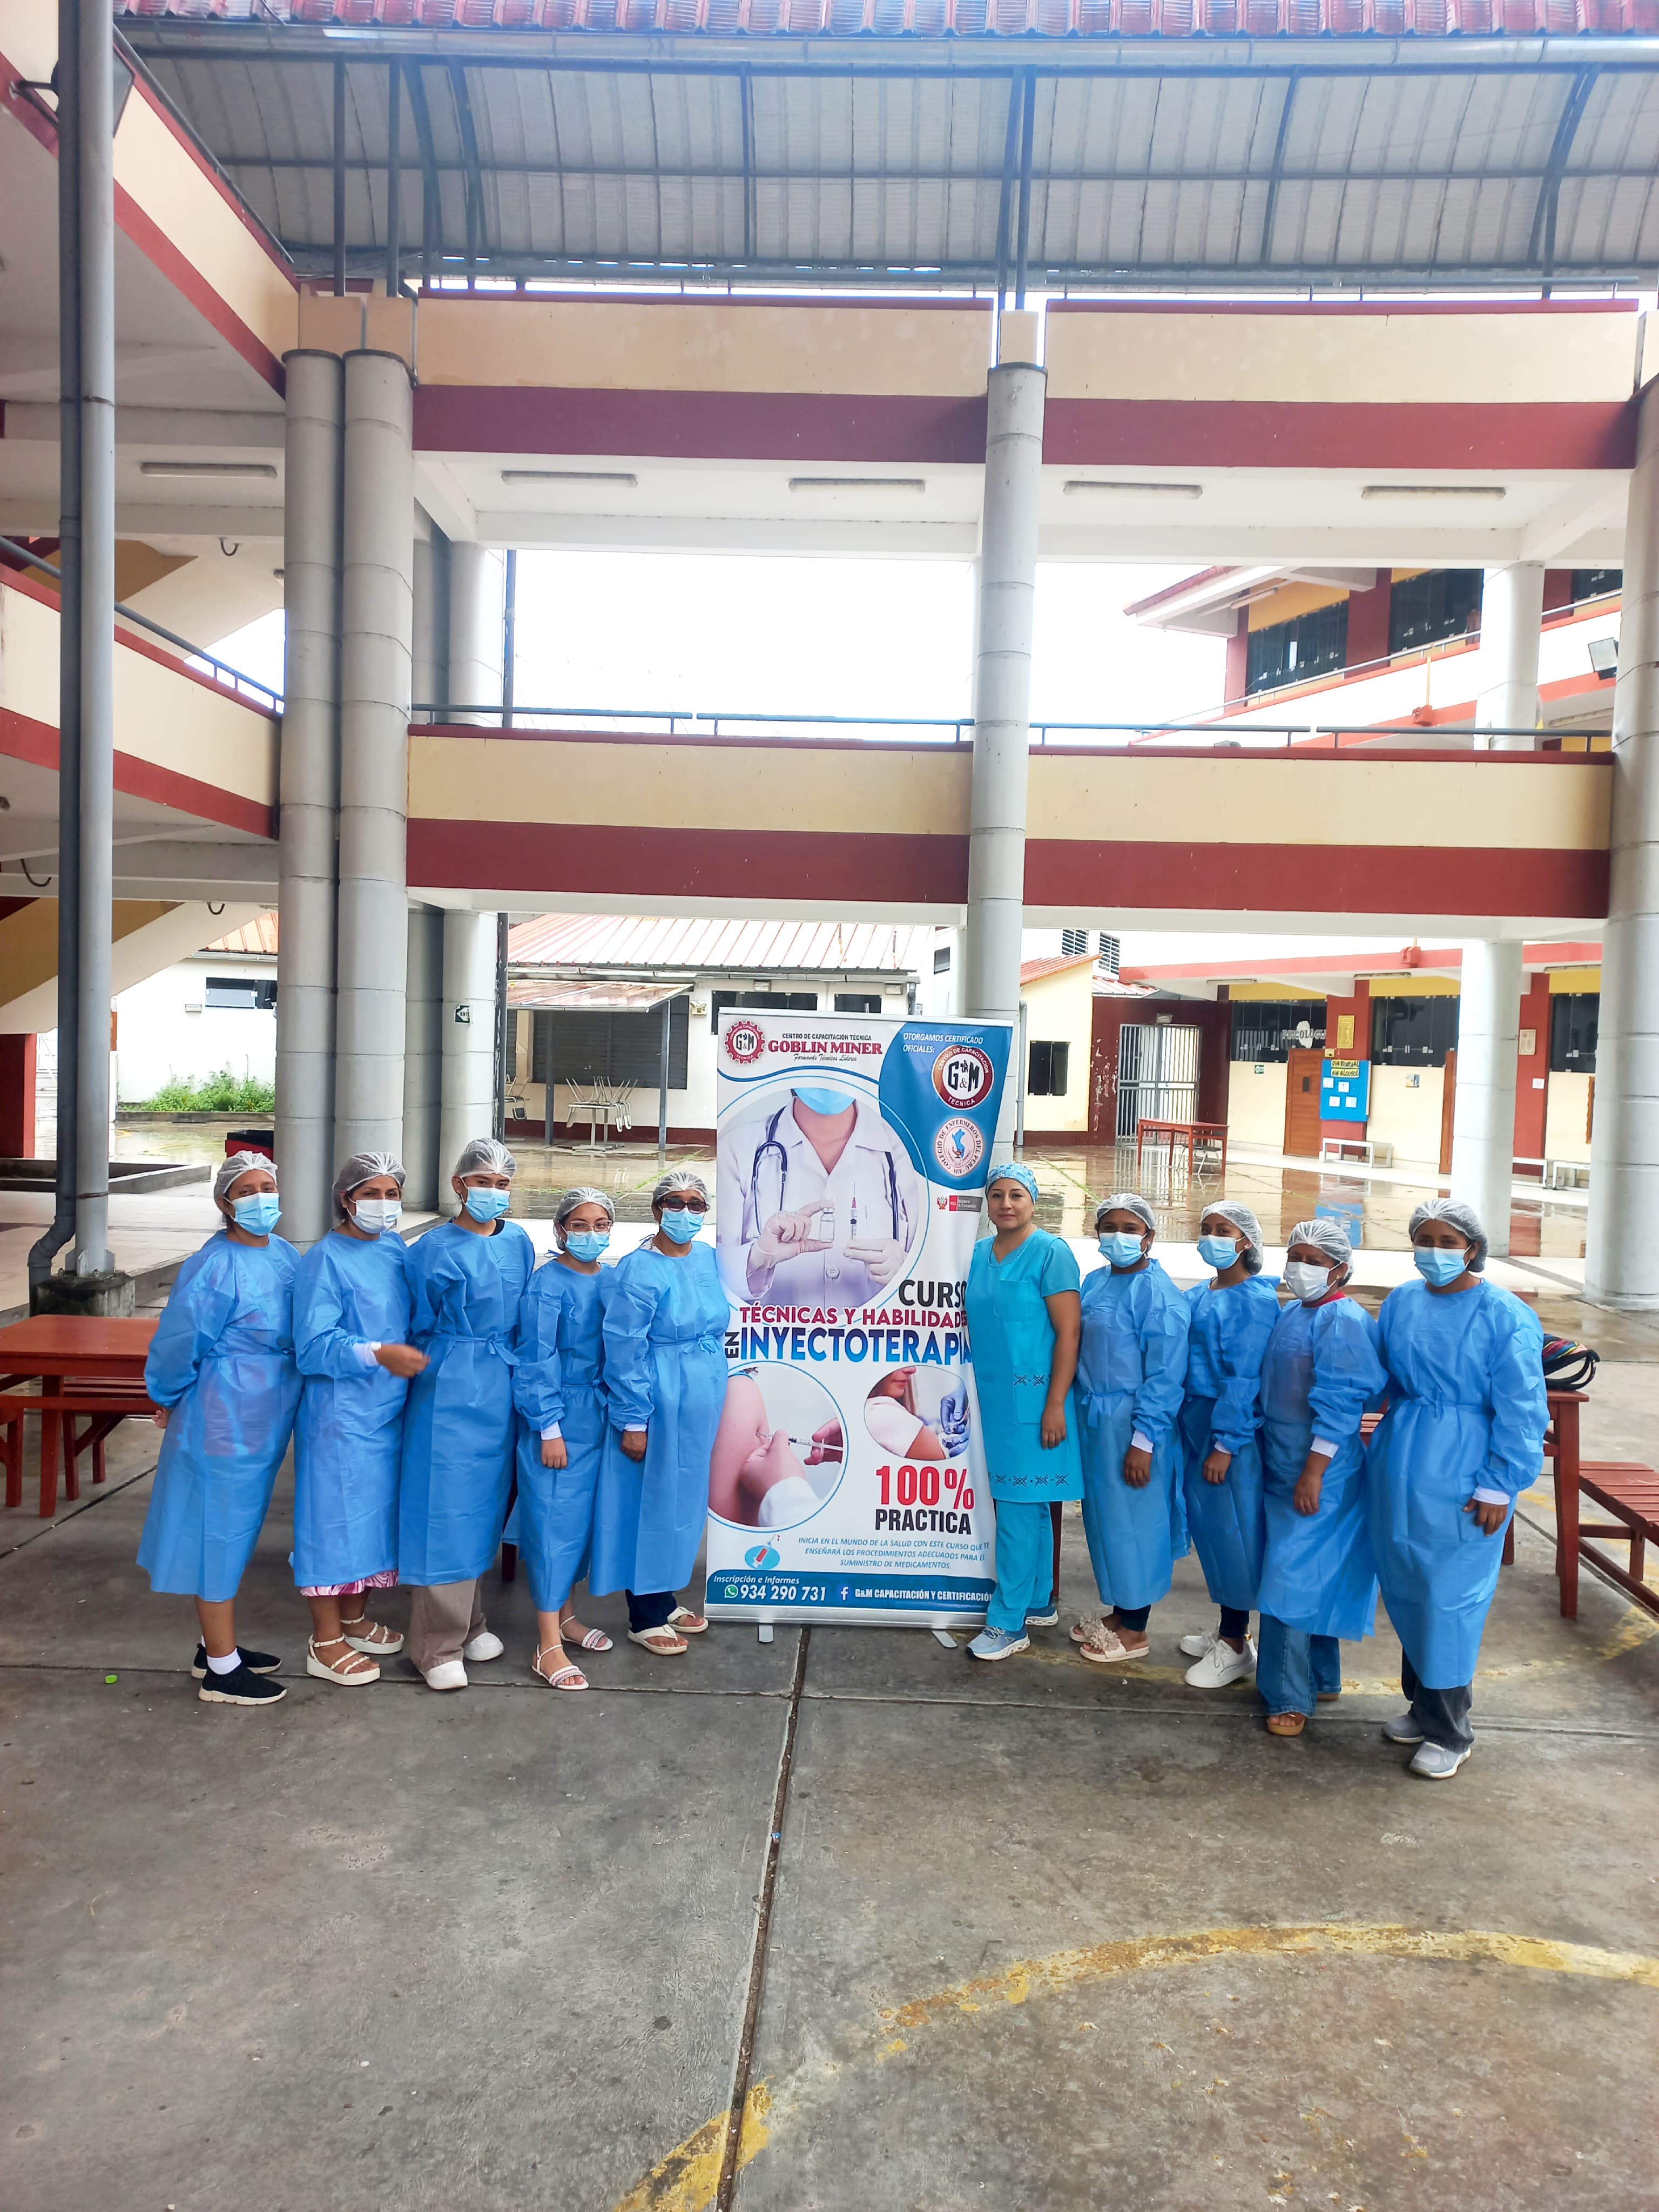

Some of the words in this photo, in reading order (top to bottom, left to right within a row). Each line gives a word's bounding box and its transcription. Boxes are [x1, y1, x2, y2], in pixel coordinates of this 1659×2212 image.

[768, 1040, 828, 1053] GOBLIN
[831, 1042, 883, 1054] MINER
[903, 1033, 943, 1042] OTORGAMOS
[945, 1034, 983, 1044] CERTIFICADO
[903, 1044, 935, 1053] OFICIALES:
[938, 1050, 953, 1070] CENTRO
[948, 1096, 976, 1107] TECNICA
[939, 1129, 946, 1139] DE
[945, 1119, 980, 1138] ENFERMEROS
[937, 1141, 951, 1170] COLEGIO
[899, 1279, 967, 1308] CURSO
[740, 1302, 838, 1324] TÉCNICAS
[844, 1309, 856, 1325] Y
[862, 1309, 968, 1328] HABILIDADES
[725, 1332, 739, 1359] EN
[741, 1327, 972, 1365] INYECTOTERAPIA
[876, 1465, 974, 1509] 100%
[875, 1509, 972, 1535] PRACTICA
[857, 1549, 916, 1558] PROCEDIMIENTOS
[918, 1550, 959, 1559] ADECUADOS
[895, 1561, 952, 1569] MEDICAMENTOS.
[714, 1575, 756, 1584] Inscripción
[765, 1576, 799, 1584] Informes
[740, 1584, 766, 1600] 934
[771, 1586, 797, 1600] 290
[801, 1586, 826, 1601] 731
[855, 1589, 873, 1597] G&M
[874, 1589, 929, 1600] CAPACITACIÓN
[931, 1591, 936, 1600] Y
